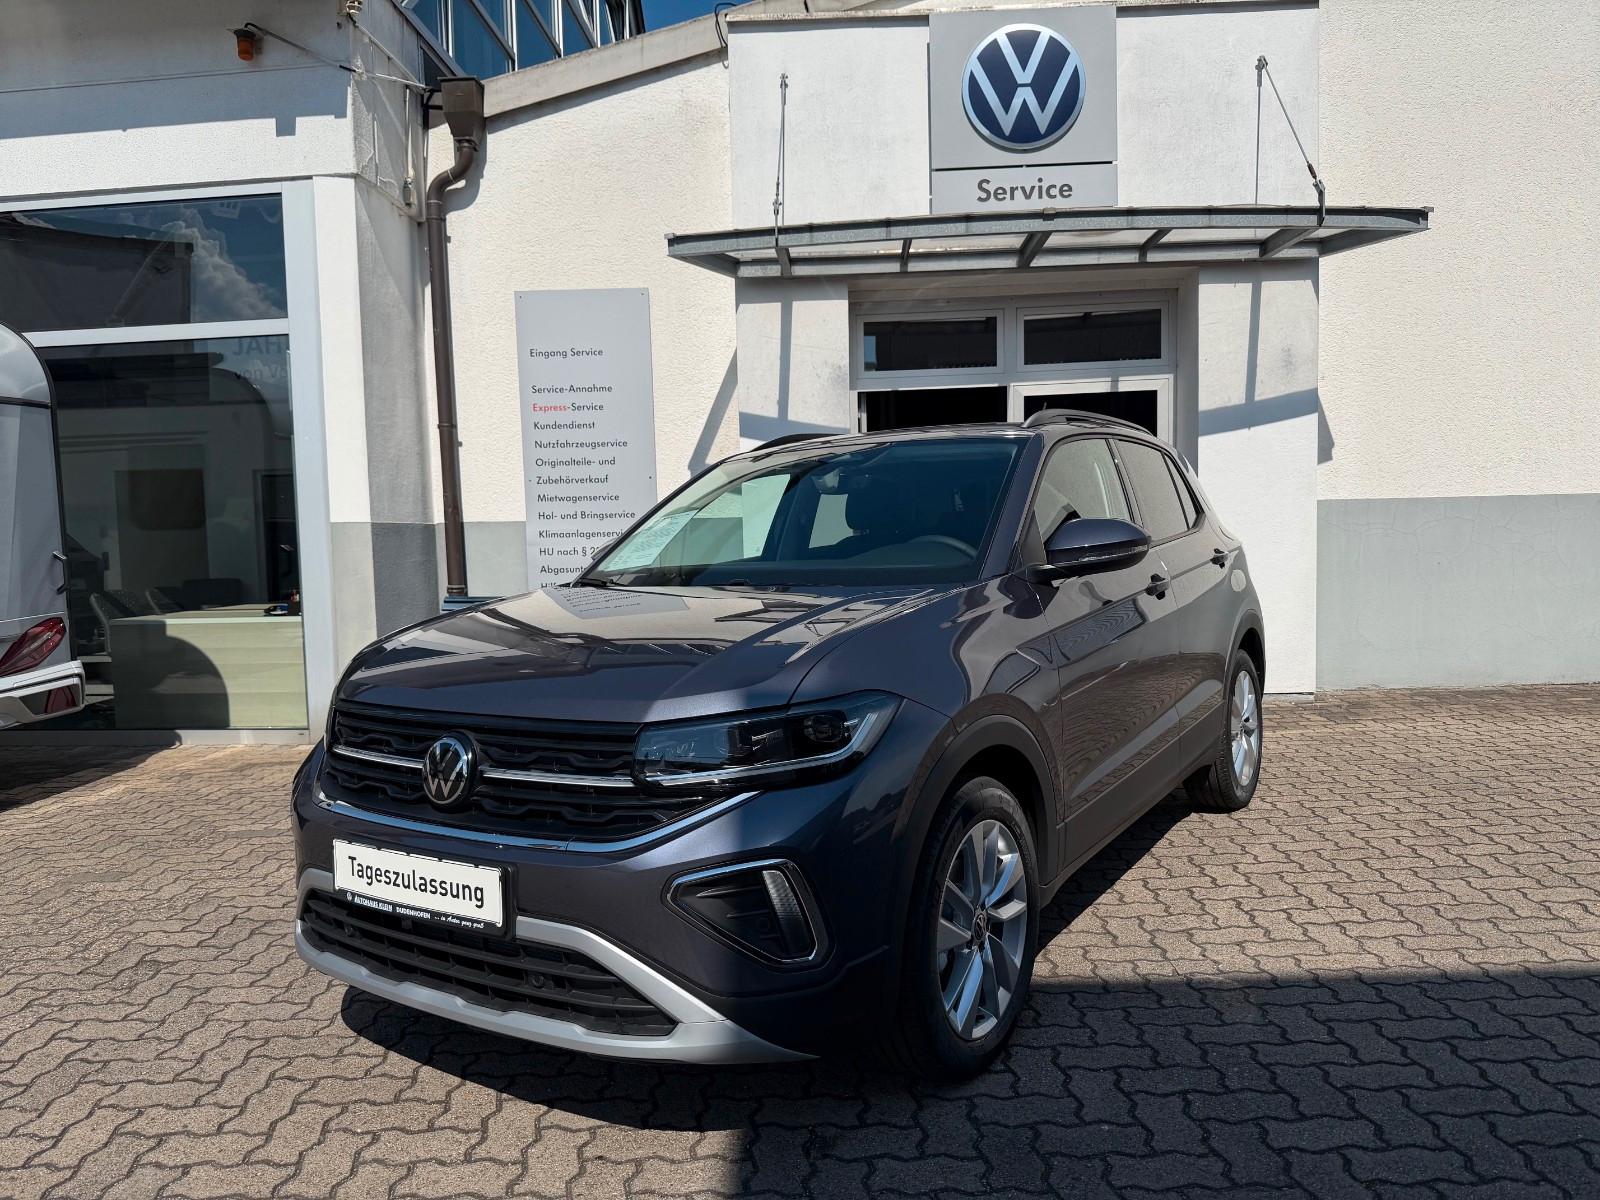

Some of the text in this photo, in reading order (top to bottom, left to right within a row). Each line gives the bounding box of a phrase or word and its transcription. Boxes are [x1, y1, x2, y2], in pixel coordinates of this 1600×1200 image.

[976, 177, 1073, 202] Service
[529, 347, 604, 359] Eingang Service
[531, 384, 613, 394] Service-Annahme
[532, 402, 604, 413] Express-Service
[533, 421, 595, 430] Kundendienst
[534, 439, 628, 450] Nutzfahrzeugservice
[535, 457, 616, 468] Originalteile- und
[536, 474, 609, 485] Zubehörverkauf
[537, 493, 620, 504] Mietwagenservice
[538, 510, 636, 521] Hol- und Bringservice
[538, 529, 624, 539] Klimaanlagenservi
[539, 547, 554, 557] HU
[557, 546, 579, 556] nach
[581, 547, 587, 557] §
[348, 855, 484, 909] Tageszulassung
[396, 906, 431, 920] DUDENHOFEN
